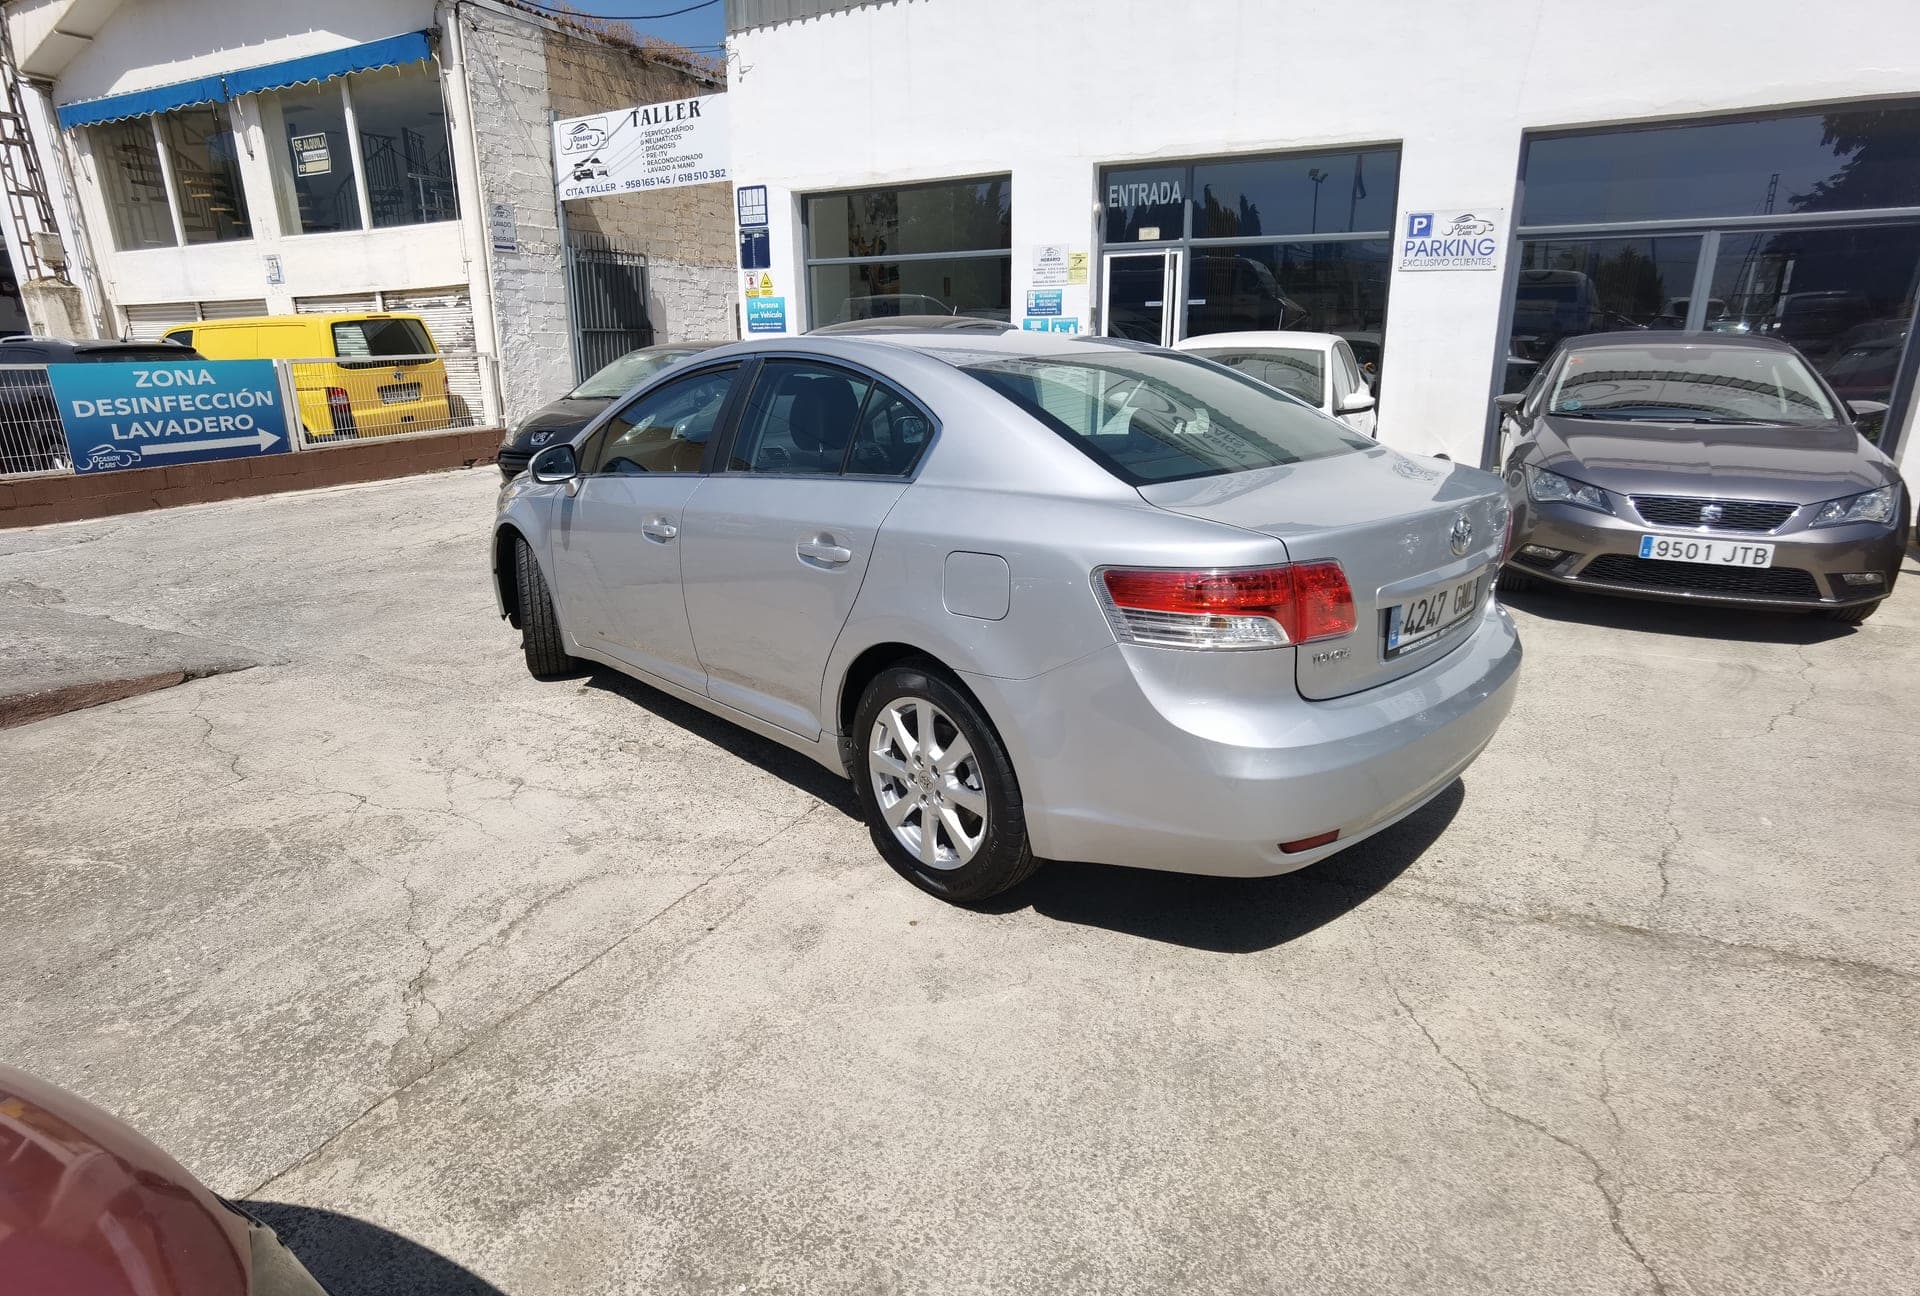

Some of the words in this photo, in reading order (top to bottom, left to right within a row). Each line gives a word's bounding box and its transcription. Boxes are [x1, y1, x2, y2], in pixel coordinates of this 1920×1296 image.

[631, 100, 701, 127] TALLER
[645, 128, 670, 138] SERVICIO
[294, 139, 303, 151] SE
[303, 136, 326, 151] ALQUILA
[647, 153, 703, 166] REACONDICIONADO
[648, 165, 671, 173] LAVADO
[677, 161, 696, 169] MANO
[565, 187, 584, 196] CITA
[585, 183, 617, 194] TALLER
[1109, 181, 1182, 208] ENTRADA
[1412, 217, 1427, 235] P
[1404, 238, 1495, 257] PARKING
[1402, 258, 1450, 267] EXCLUSIVO
[1452, 257, 1492, 266] CLIENTES
[133, 369, 216, 388] ZONA
[72, 388, 274, 418] DESINFECCIÓN
[111, 414, 254, 440] LAVADERO
[92, 455, 120, 463] OCASION
[1656, 541, 1712, 561] 9501
[1722, 546, 1768, 565] JTB
[1404, 590, 1448, 636] 4247
